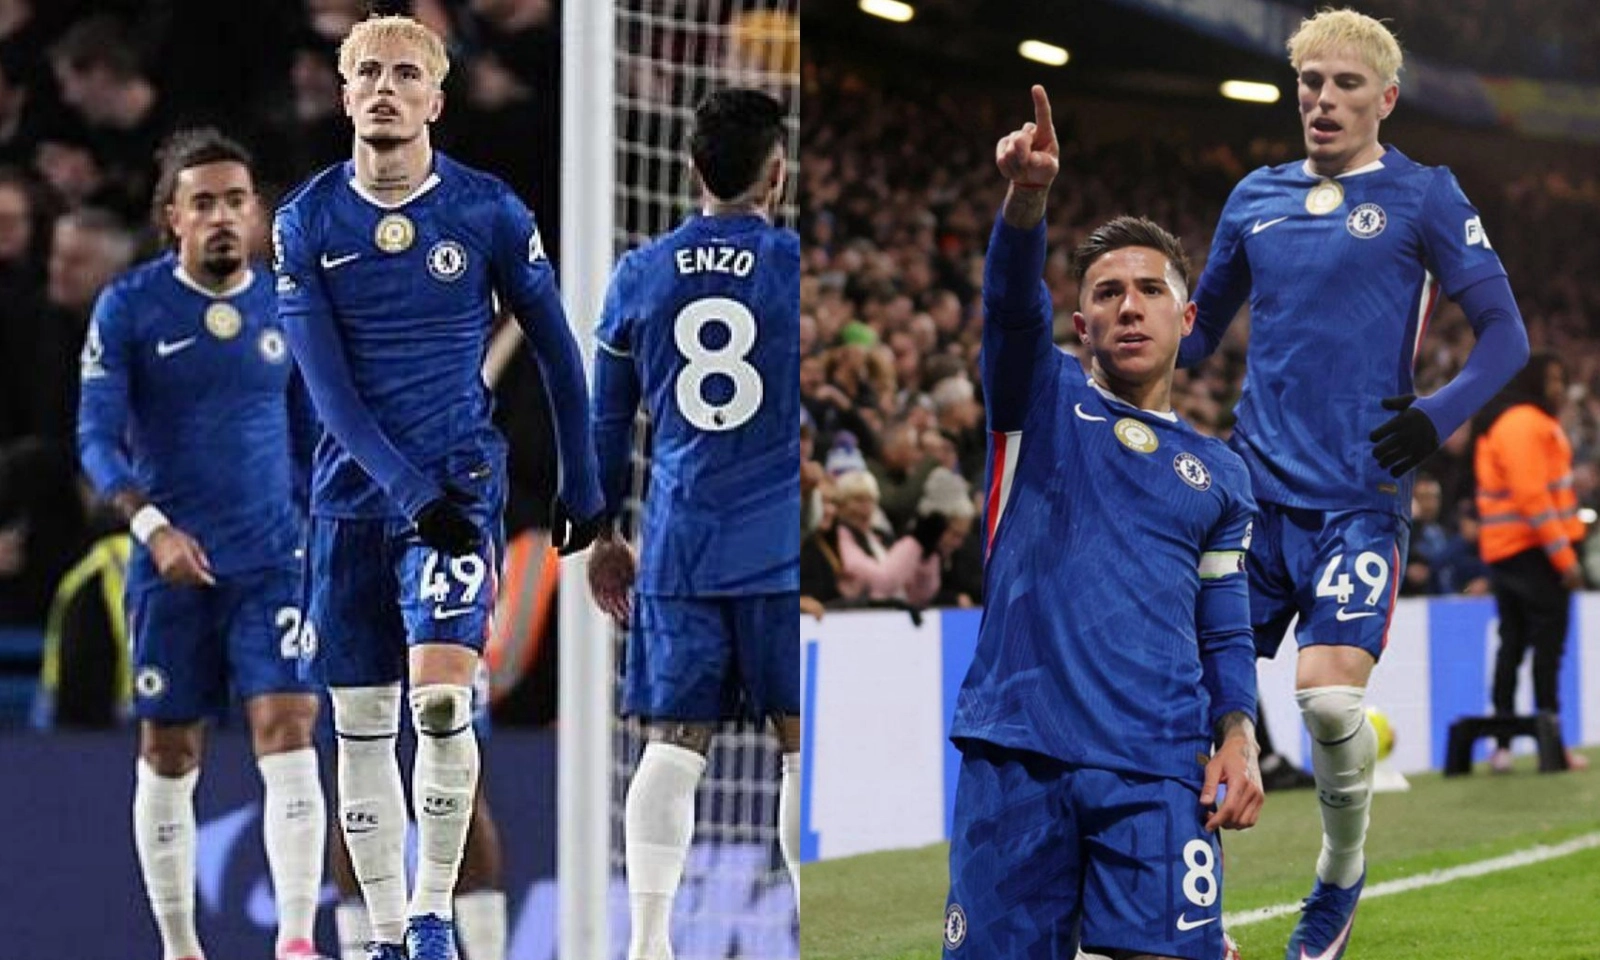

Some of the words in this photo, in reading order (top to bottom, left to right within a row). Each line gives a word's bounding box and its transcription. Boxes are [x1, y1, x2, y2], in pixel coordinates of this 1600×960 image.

[675, 246, 756, 278] ENZO
[673, 297, 764, 432] 8
[420, 550, 487, 603] 49
[1316, 550, 1390, 607] 49
[1182, 838, 1218, 908] 8
